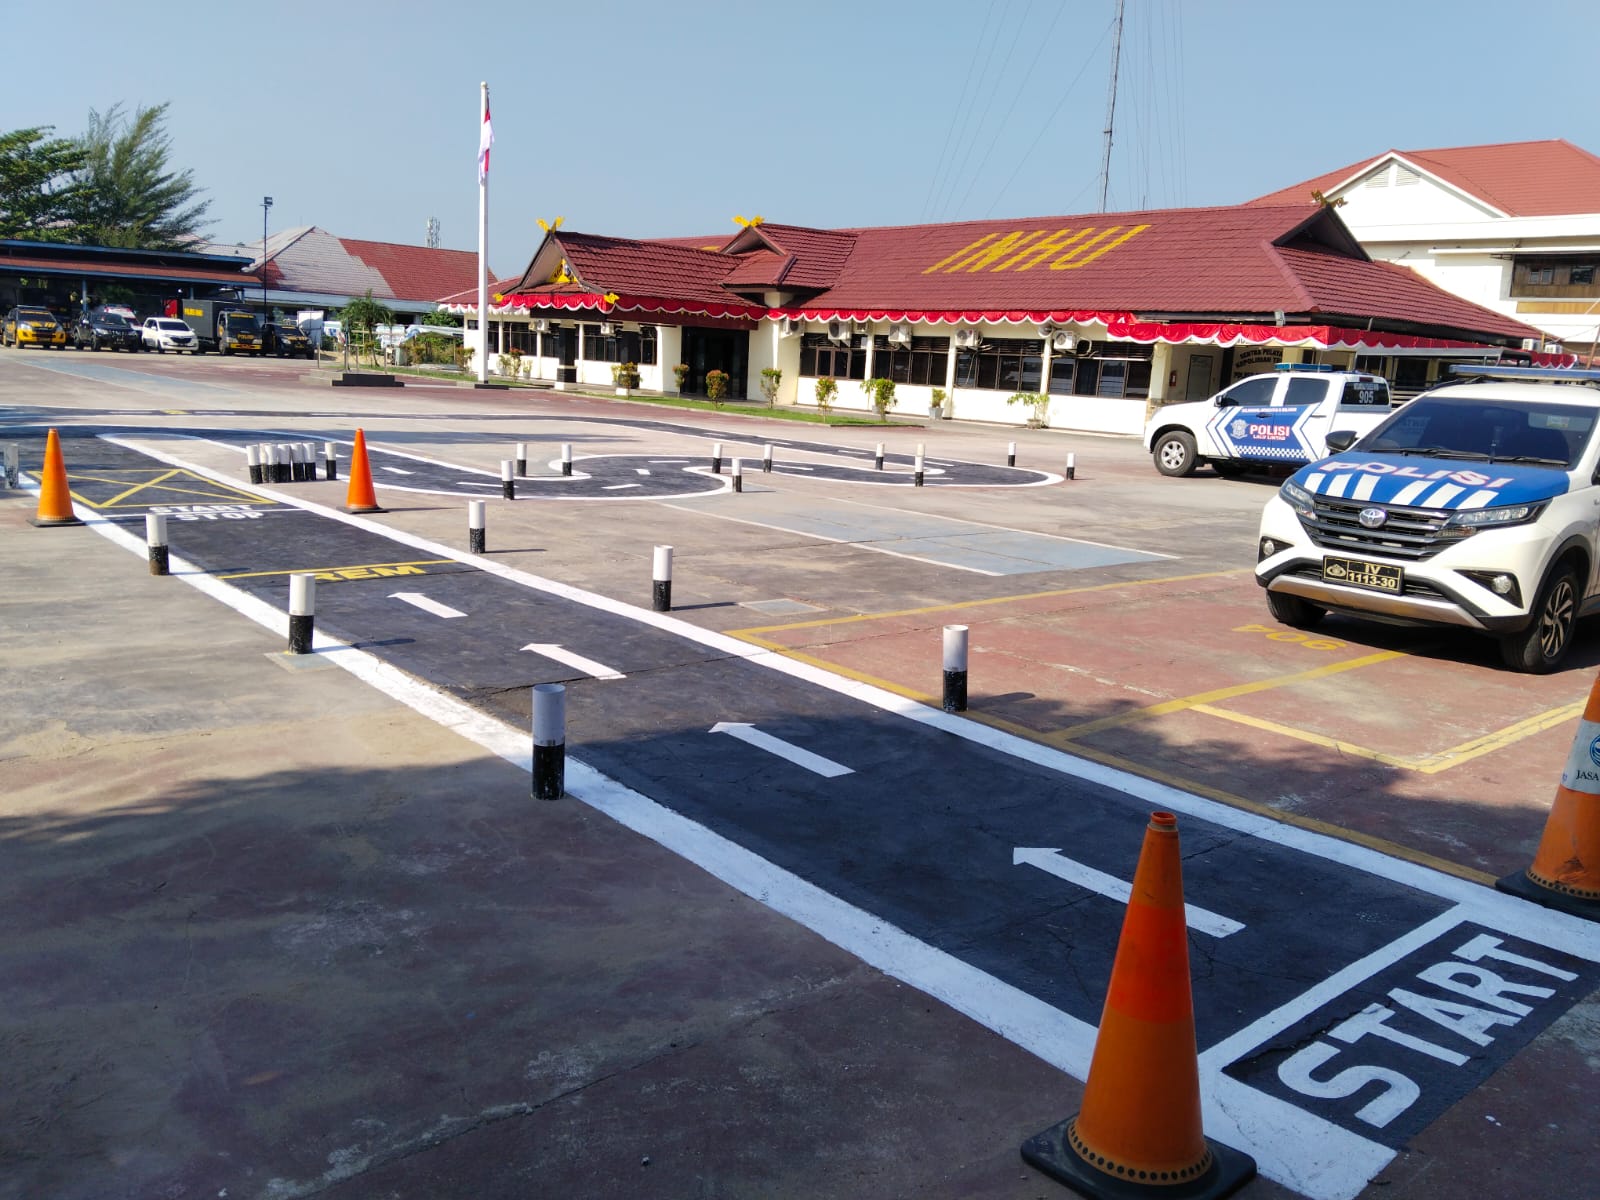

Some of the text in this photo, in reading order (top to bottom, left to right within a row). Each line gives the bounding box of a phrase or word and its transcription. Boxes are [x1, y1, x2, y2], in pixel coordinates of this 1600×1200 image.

[921, 224, 1152, 274] INHU
[1359, 390, 1374, 404] 905
[1250, 424, 1290, 437] POLISI
[1319, 461, 1514, 488] POLISI
[149, 505, 252, 513] START
[175, 512, 264, 520] STOP
[1364, 563, 1381, 575] IV
[1348, 572, 1396, 588] 1113-30
[1575, 769, 1599, 781] JASA
[1277, 933, 1580, 1128] START
